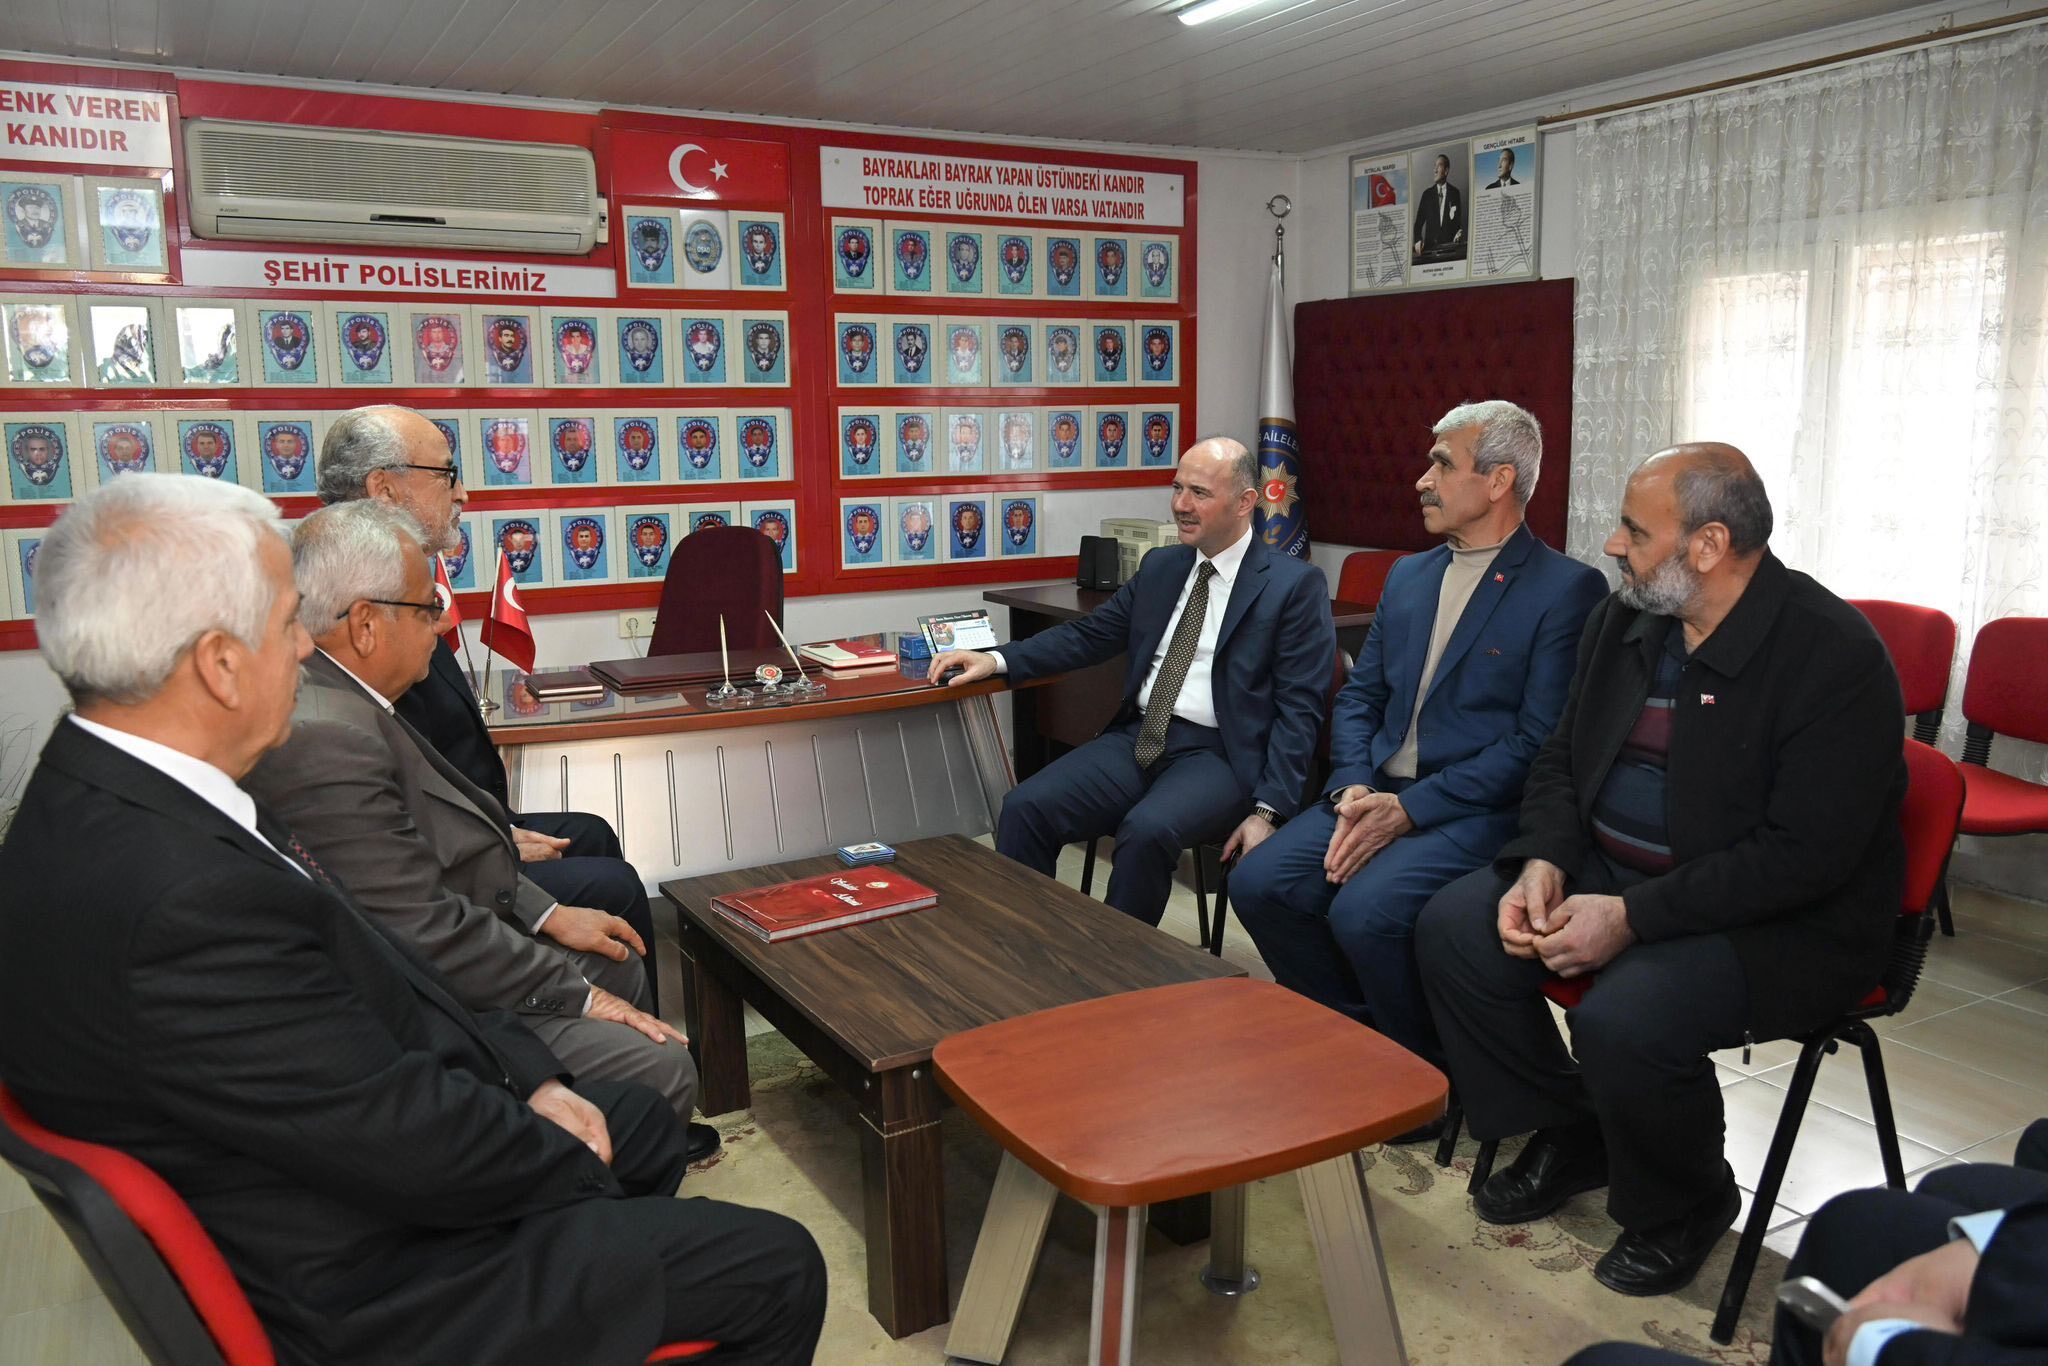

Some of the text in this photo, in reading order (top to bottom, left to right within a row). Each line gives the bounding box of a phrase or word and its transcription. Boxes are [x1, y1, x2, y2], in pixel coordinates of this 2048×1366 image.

[0, 89, 161, 123] ENK VEREN
[7, 123, 129, 152] KANIDIR
[863, 157, 1145, 194] BAYRAKLARI BAYRAK YAPAN ÜSTÜNDEKİ KANDIR
[863, 184, 1145, 220] TOPRAK EĞER UĞRUNDA ÖLEN VARSA VATANDIR
[264, 257, 547, 292] ŞEHİT POLİSLERİMİZ
[1263, 430, 1298, 451] AİLELE
